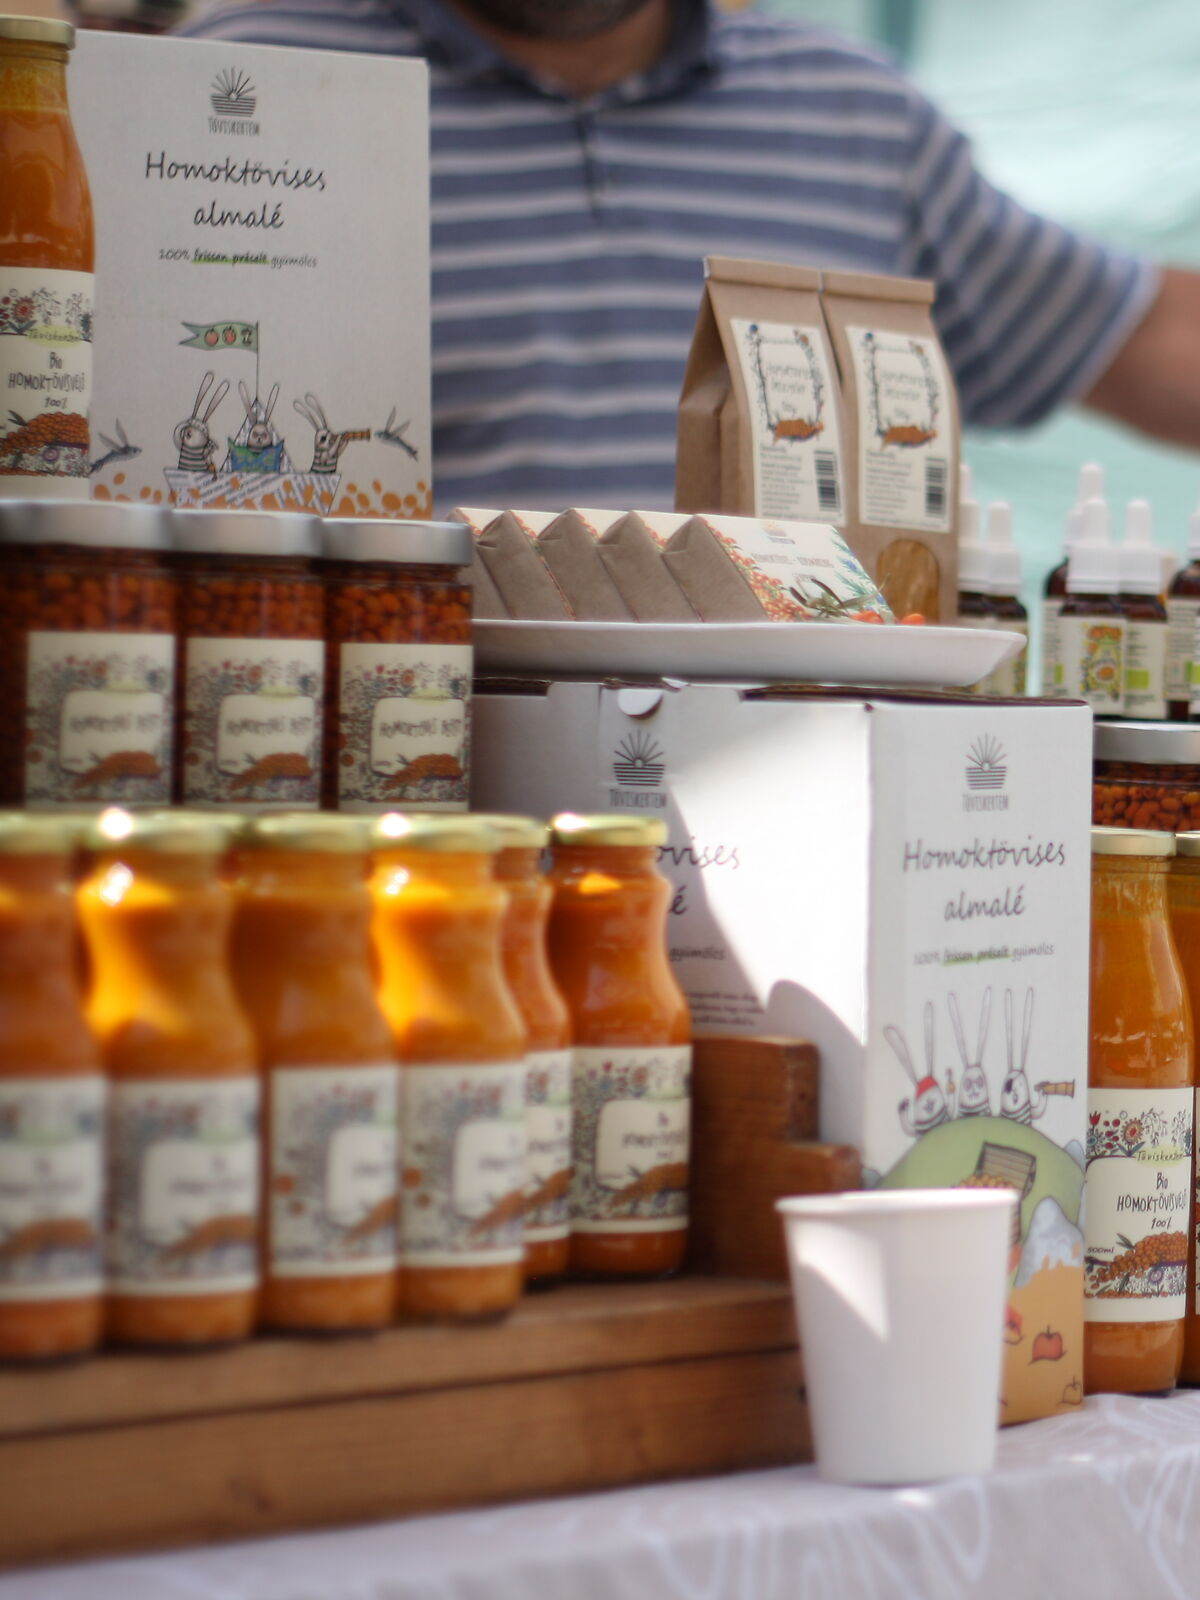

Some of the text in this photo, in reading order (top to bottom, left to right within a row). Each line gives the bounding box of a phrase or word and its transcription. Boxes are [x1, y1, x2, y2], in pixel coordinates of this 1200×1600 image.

[145, 151, 326, 191] Homoktövises
[193, 200, 284, 229] almalé
[903, 835, 1065, 872] Homoktövises
[944, 885, 1025, 921] almalé
[1156, 1172, 1169, 1190] Bio
